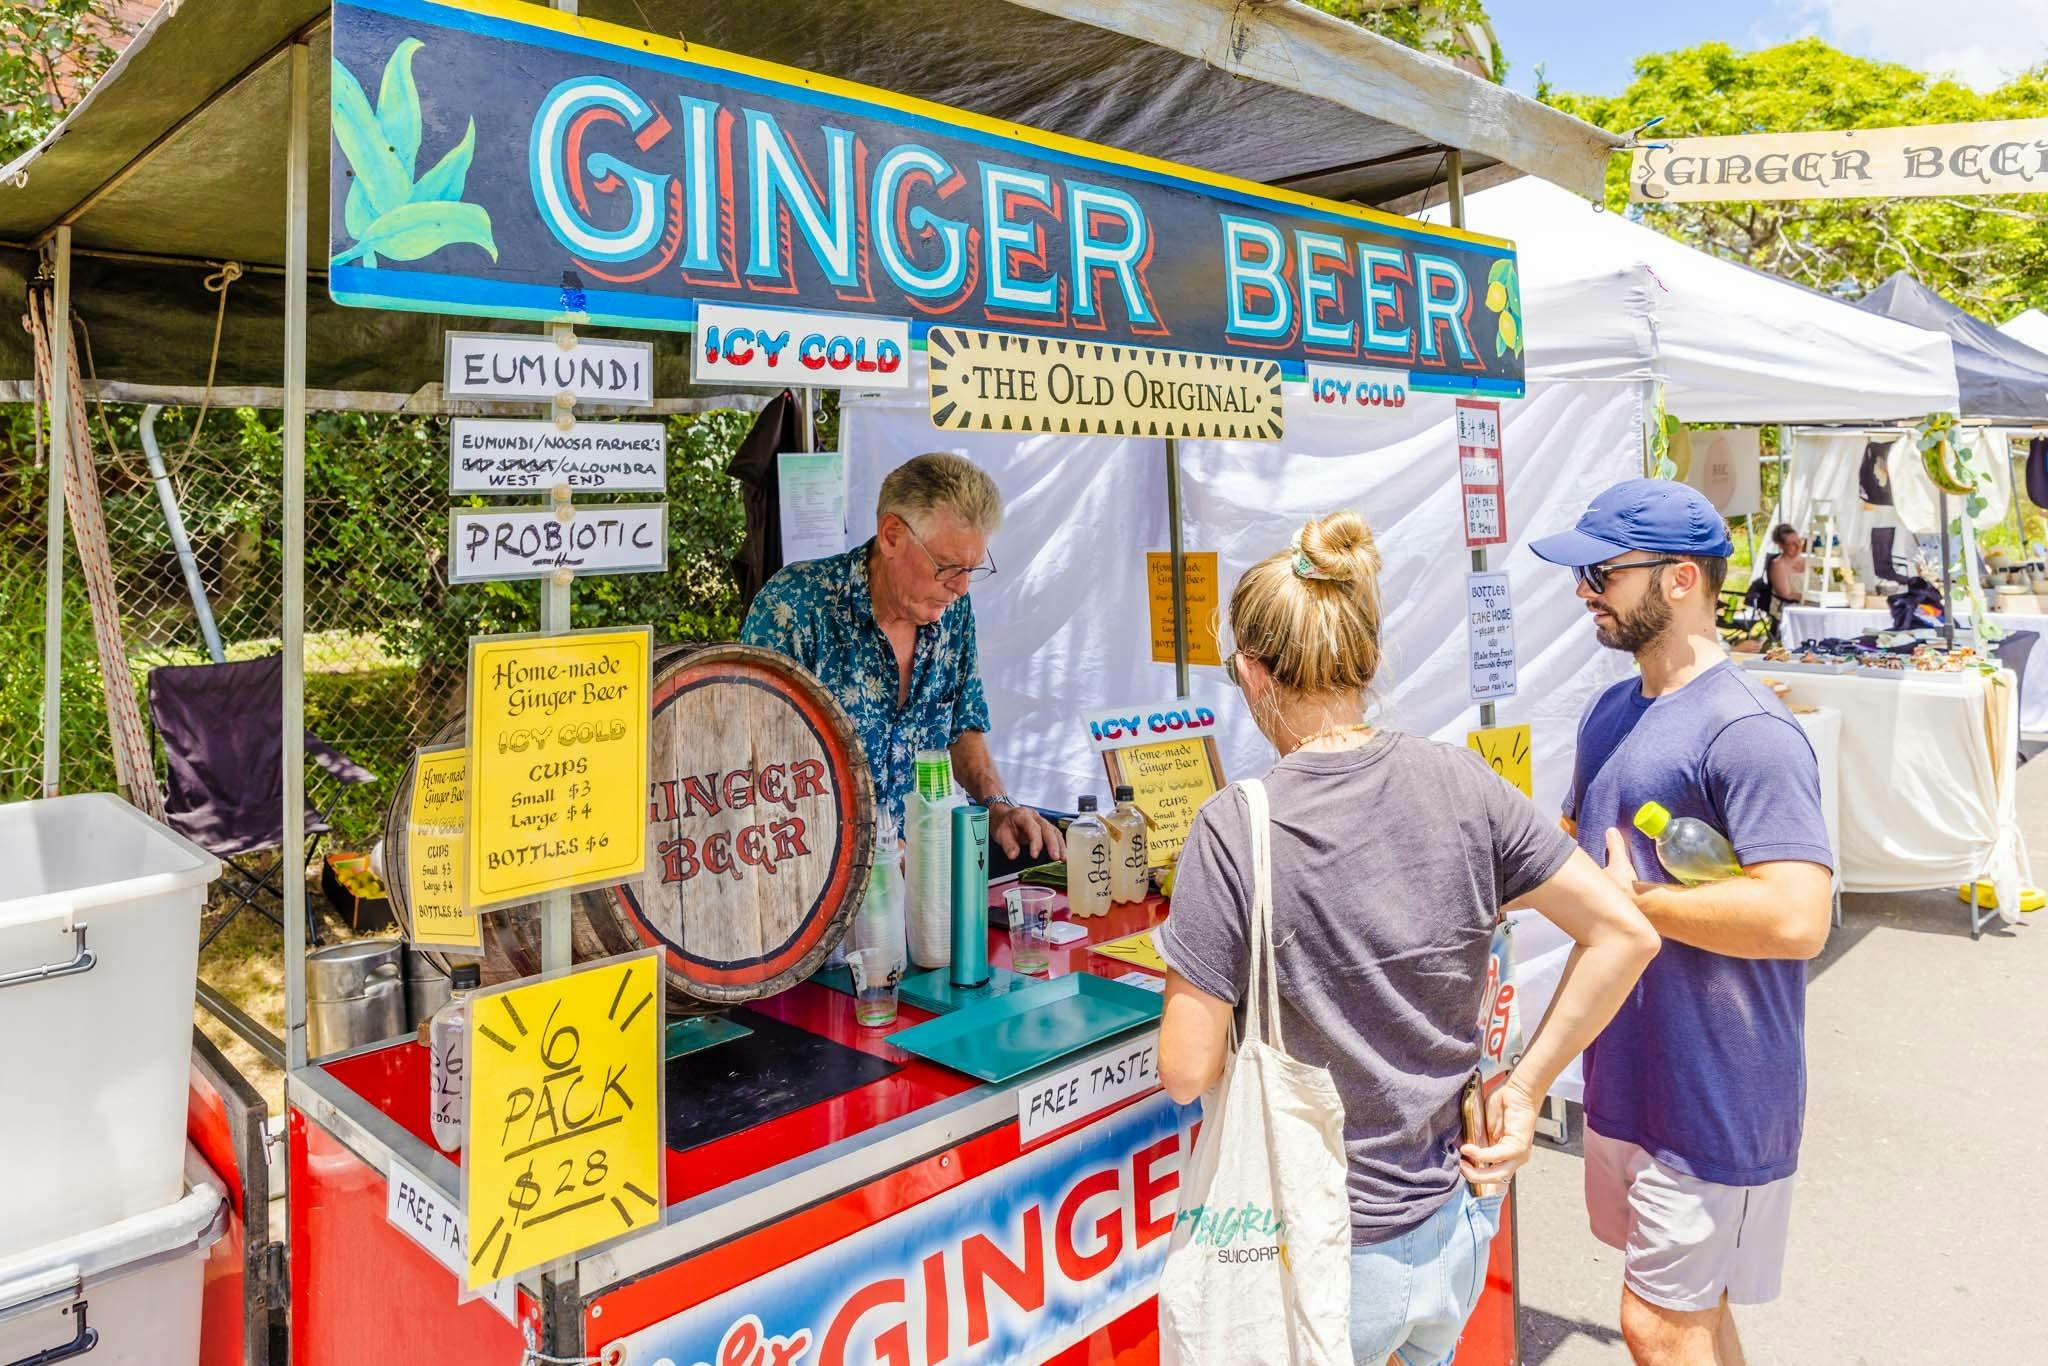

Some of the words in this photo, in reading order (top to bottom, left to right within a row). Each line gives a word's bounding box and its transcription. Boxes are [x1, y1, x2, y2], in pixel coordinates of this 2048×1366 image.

[1663, 149, 1872, 187] GINGER
[530, 75, 1168, 334] GINGER
[1220, 213, 1486, 369] BEER
[704, 326, 790, 367] ICY
[798, 331, 901, 374] COLD
[464, 353, 639, 391] EUMUNDI
[971, 366, 1037, 401] THE
[1312, 376, 1352, 404] ICY
[1356, 380, 1405, 409] COLD
[596, 437, 660, 452] FARMER'S
[489, 474, 541, 487] WEST
[568, 473, 605, 487] END
[466, 520, 654, 562] PROBIOTIC
[1471, 585, 1505, 598] BOTTLES
[1484, 599, 1494, 608] TO
[1472, 611, 1491, 624] TAKE
[491, 655, 621, 691] Home-made
[507, 688, 577, 717] Ginger
[582, 682, 630, 705] Beer
[498, 726, 553, 754] ICY
[557, 718, 626, 747] COLD
[1089, 715, 1141, 741] ICY
[1147, 706, 1215, 733] COLD
[1138, 761, 1173, 777] Ginger
[1175, 758, 1199, 770] Beer
[424, 789, 450, 810] Ginger
[511, 788, 555, 808] Small
[649, 758, 829, 824] INGER
[510, 811, 558, 831] Large
[1153, 811, 1175, 821] Small
[488, 837, 579, 870] BOTTLES
[586, 832, 609, 853] $6
[657, 816, 812, 884] BEER
[422, 864, 438, 876] Small
[423, 881, 441, 895] Large
[418, 904, 452, 919] BOTTLES
[541, 999, 581, 1070] 6
[501, 1064, 634, 1147] PACK
[1028, 1077, 1079, 1127] FREE
[507, 1150, 609, 1227] $28
[397, 1182, 434, 1232] FREE
[818, 1121, 1200, 1366] GINGE
